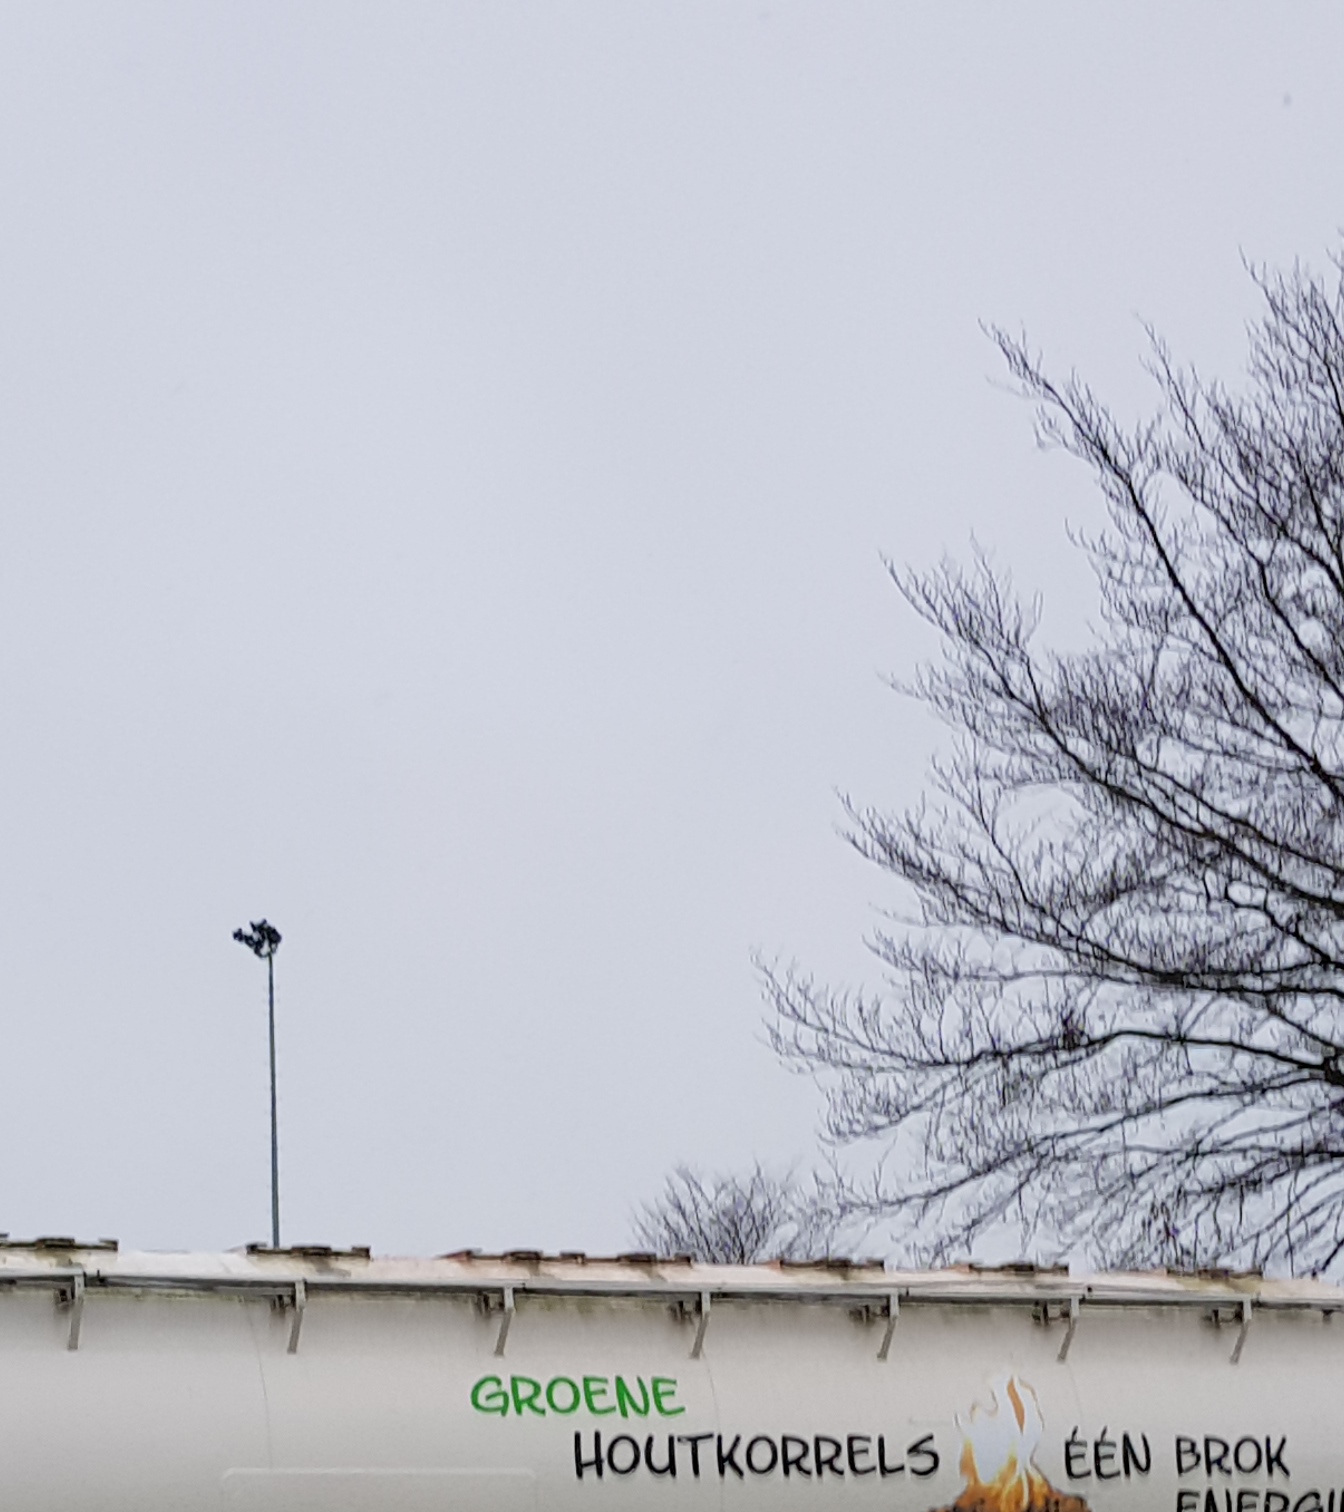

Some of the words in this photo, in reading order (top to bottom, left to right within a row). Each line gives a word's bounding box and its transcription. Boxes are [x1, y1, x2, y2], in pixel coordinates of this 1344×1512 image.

[470, 1375, 686, 1418] GROENE
[574, 1430, 940, 1479] HOUTKORRELS
[1064, 1425, 1152, 1479] ÉÉN
[1175, 1434, 1290, 1478] BROK
